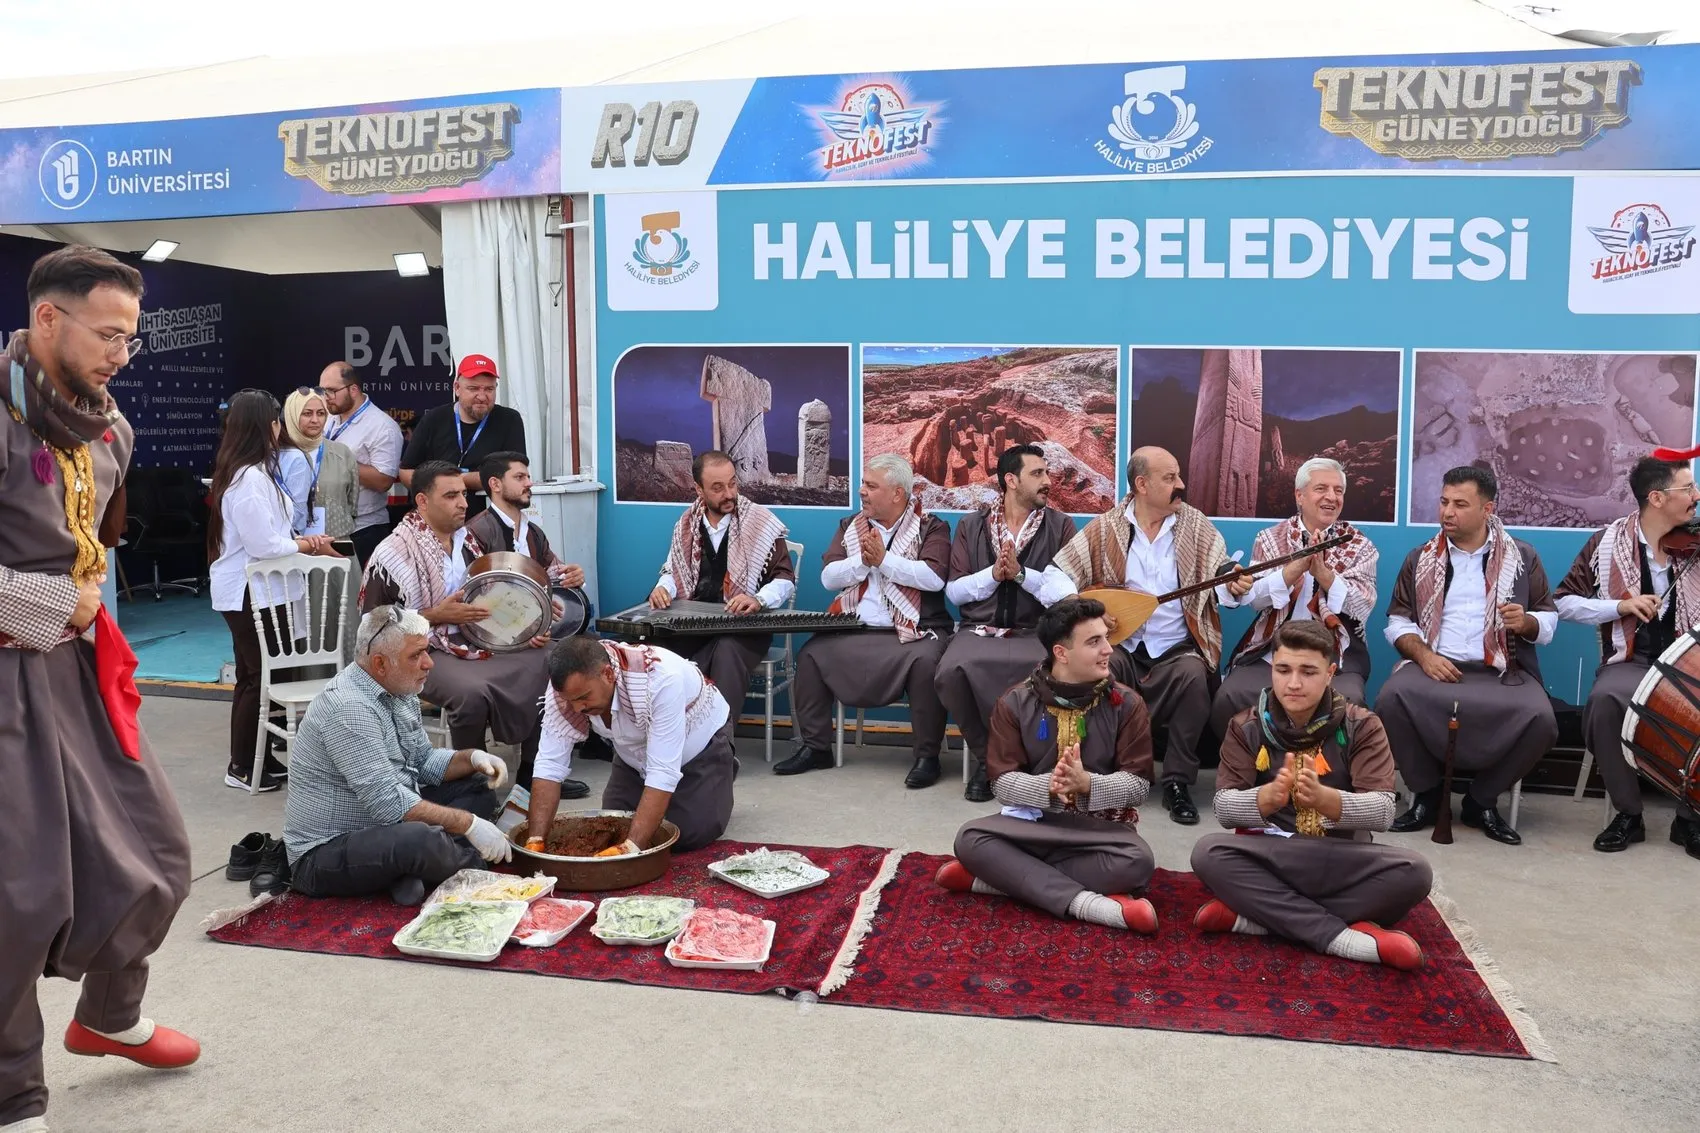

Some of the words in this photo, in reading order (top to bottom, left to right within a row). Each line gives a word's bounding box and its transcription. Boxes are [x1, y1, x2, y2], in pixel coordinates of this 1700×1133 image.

[1316, 60, 1640, 115] TEKNOFEST
[281, 103, 518, 160] TEKNOFEST
[591, 100, 699, 168] R10
[1375, 111, 1584, 142] GÜNEYDOĞU
[107, 148, 172, 168] BARTIN
[822, 120, 931, 169] TEKNOFEST
[1094, 139, 1144, 173] HALİLİYE
[1147, 135, 1214, 173] BELEDİYESİ
[326, 147, 478, 182] GÜNEYDOĞU
[107, 168, 230, 195] ÜNİVERSİTESİ
[1590, 237, 1697, 279] TEKNOFEST
[141, 304, 221, 331] İHTİSASLAŞAN
[151, 326, 215, 352] ÜNİVERSİTE
[108, 380, 143, 388] ULAMALARI
[362, 382, 392, 391] RTIN
[400, 380, 450, 391] ÜNİVER
[135, 426, 167, 436] ÜRÜLEBİLİR
